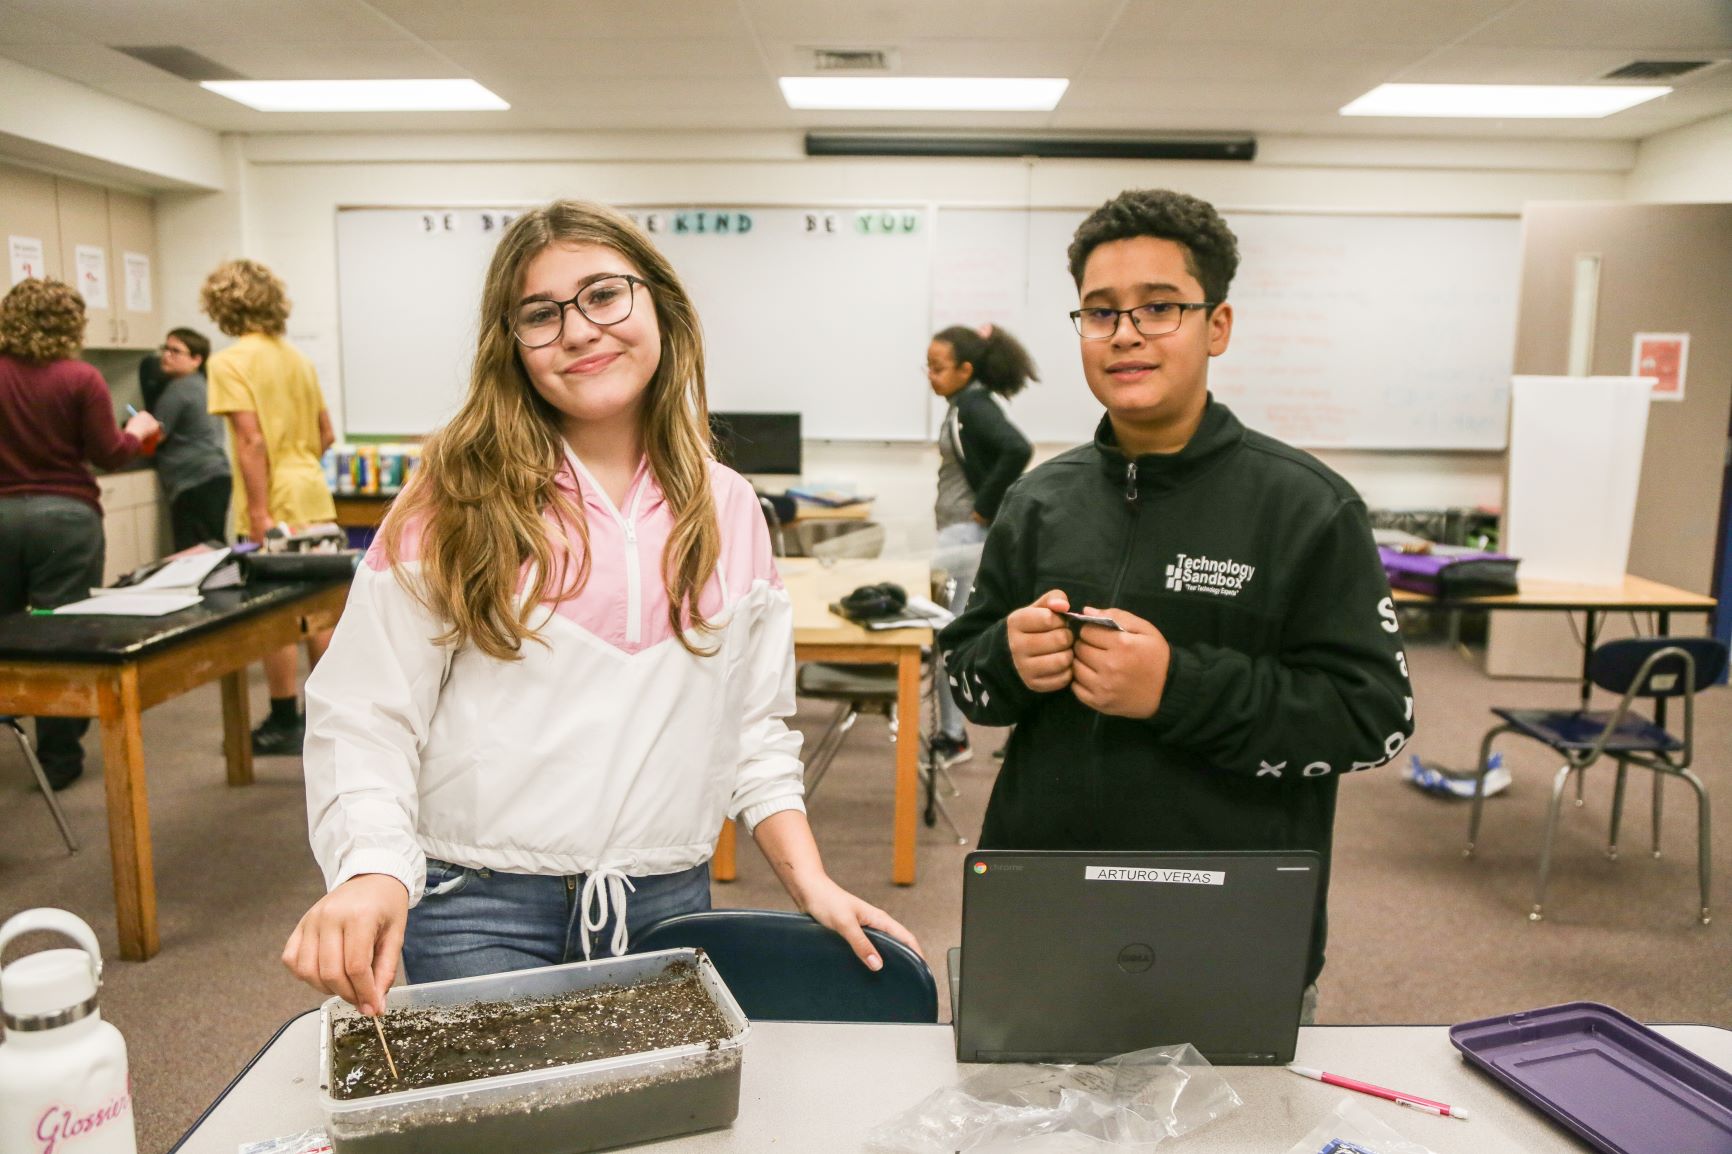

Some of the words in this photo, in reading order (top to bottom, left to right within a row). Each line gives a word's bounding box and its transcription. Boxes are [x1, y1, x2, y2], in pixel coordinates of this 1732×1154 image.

[675, 212, 752, 234] KIND
[805, 214, 835, 232] BE
[859, 214, 916, 232] YOU
[1177, 553, 1255, 581] Technology
[1182, 568, 1242, 589] Sandbox
[1097, 868, 1159, 882] ARTURO
[1163, 871, 1212, 884] VERAS
